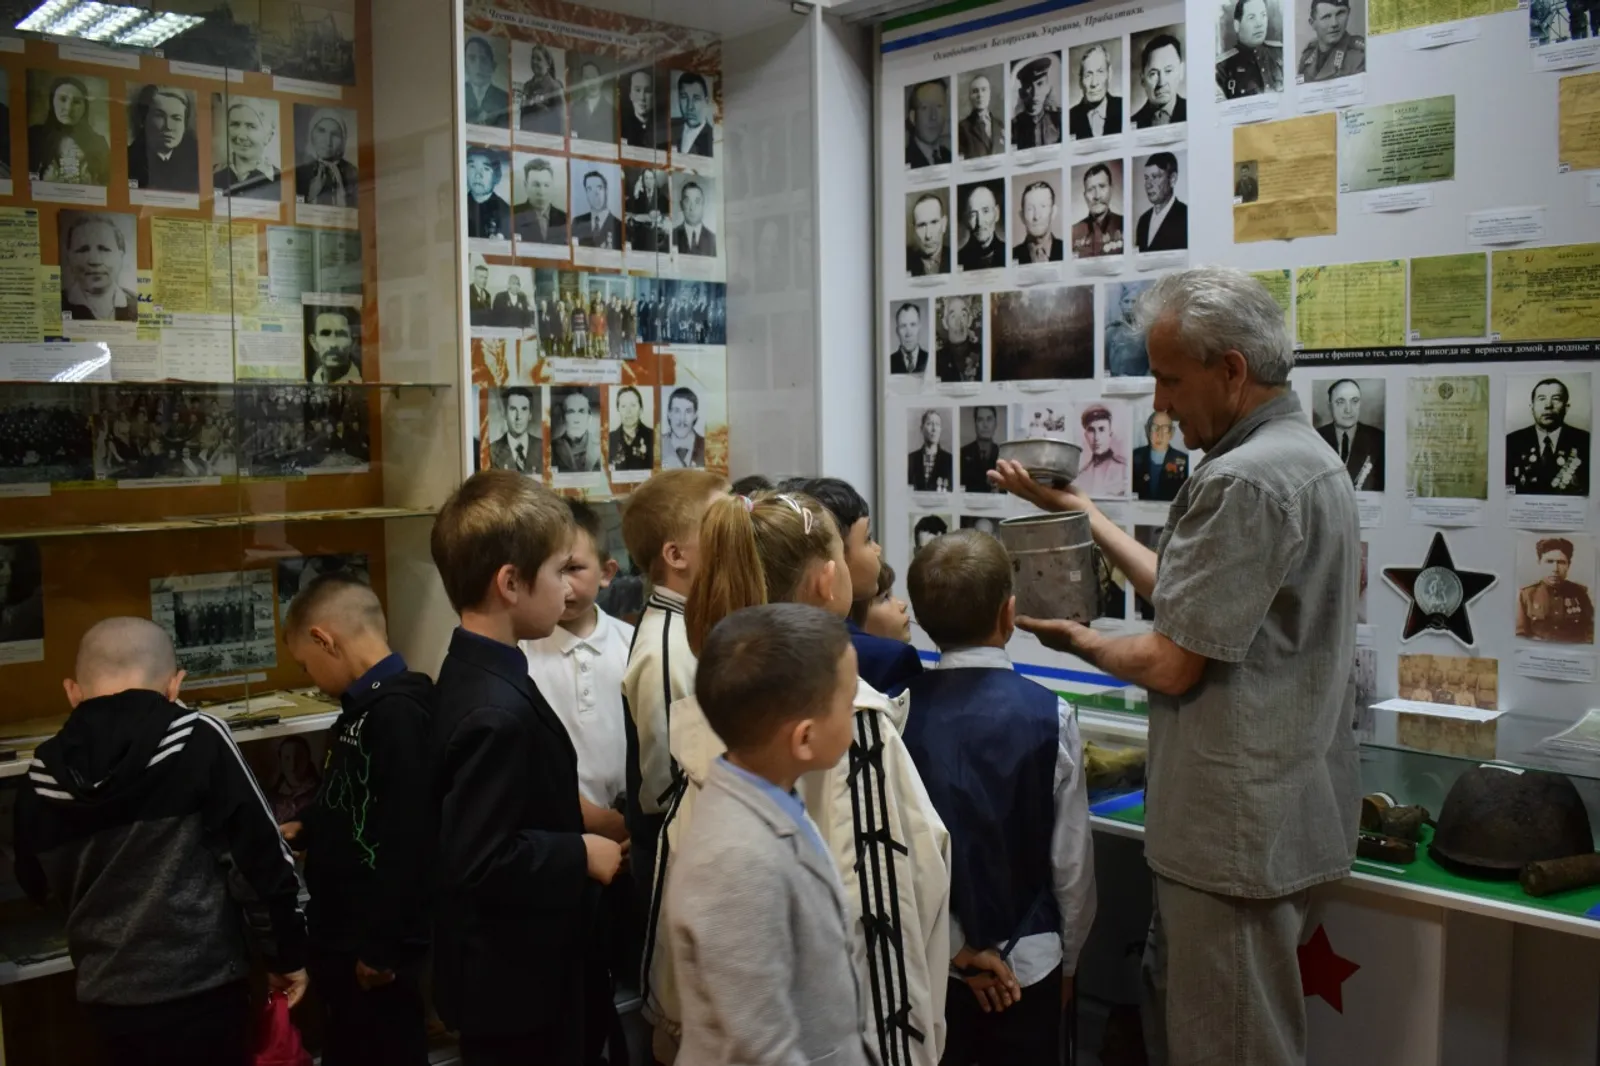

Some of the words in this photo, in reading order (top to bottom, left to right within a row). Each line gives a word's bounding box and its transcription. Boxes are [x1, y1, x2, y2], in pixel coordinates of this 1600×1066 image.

[1331, 350, 1363, 360] фронтов
[1373, 350, 1387, 358] тех,
[1405, 349, 1421, 358] уже
[1424, 347, 1458, 356] никогда
[1515, 344, 1545, 354] домой,
[1555, 344, 1590, 353] родные
